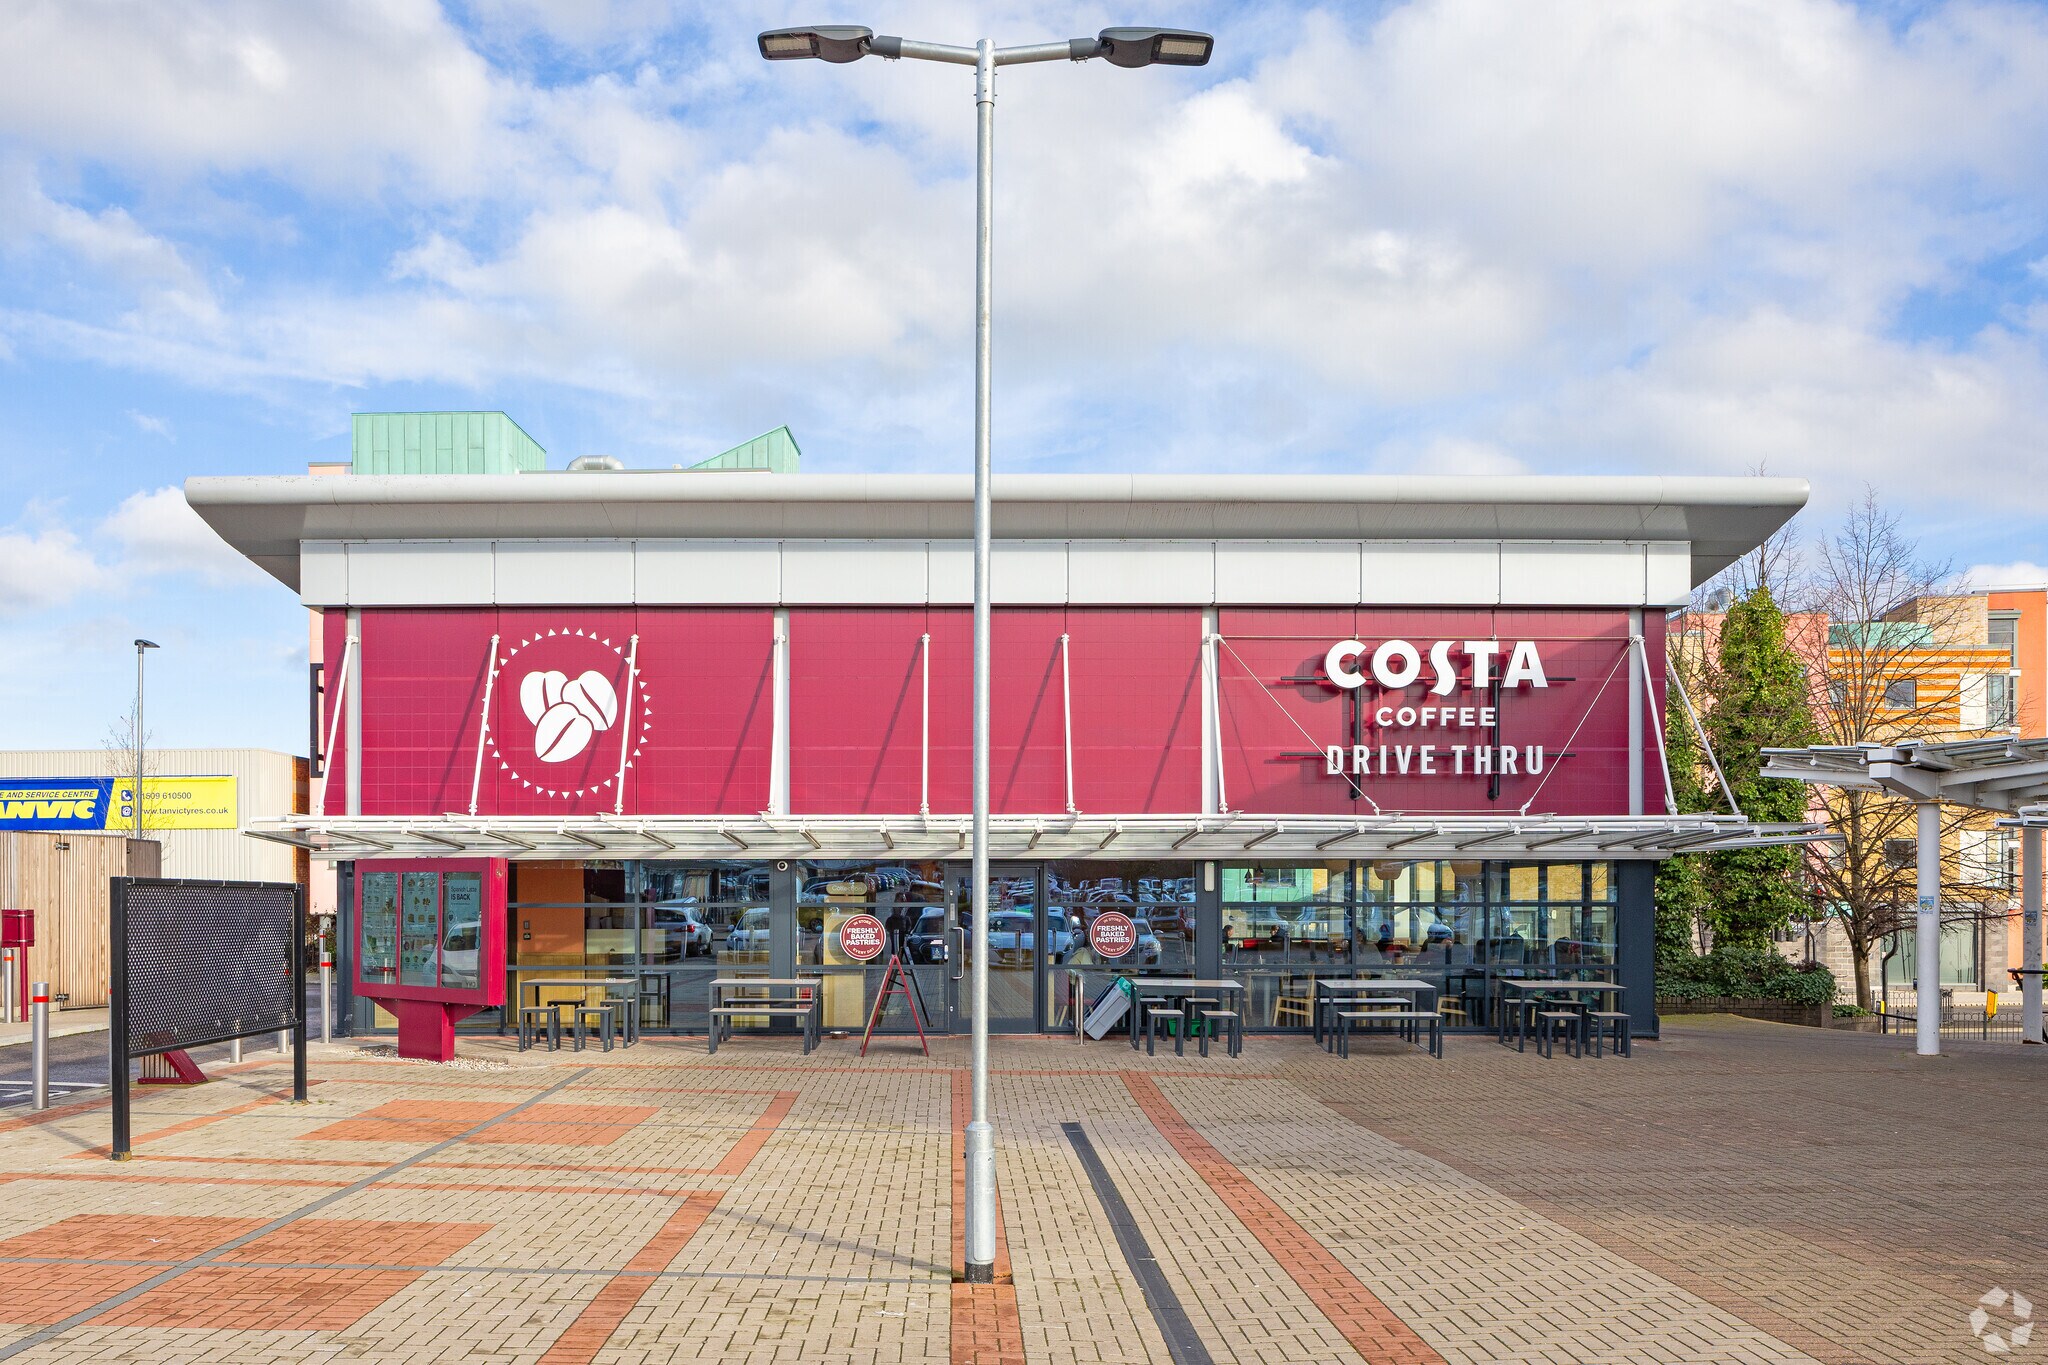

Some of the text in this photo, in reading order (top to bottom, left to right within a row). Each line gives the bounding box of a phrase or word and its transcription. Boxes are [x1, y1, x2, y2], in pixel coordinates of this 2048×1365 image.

[1325, 639, 1548, 696] COSTA
[1376, 706, 1496, 727] COFFEE
[1327, 745, 1543, 775] DRIVE THRU
[25, 791, 60, 799] SERVICE
[62, 790, 95, 798] CENTRE
[162, 792, 192, 800] 610500
[140, 807, 229, 816] ww.tanvictyres.co.uk
